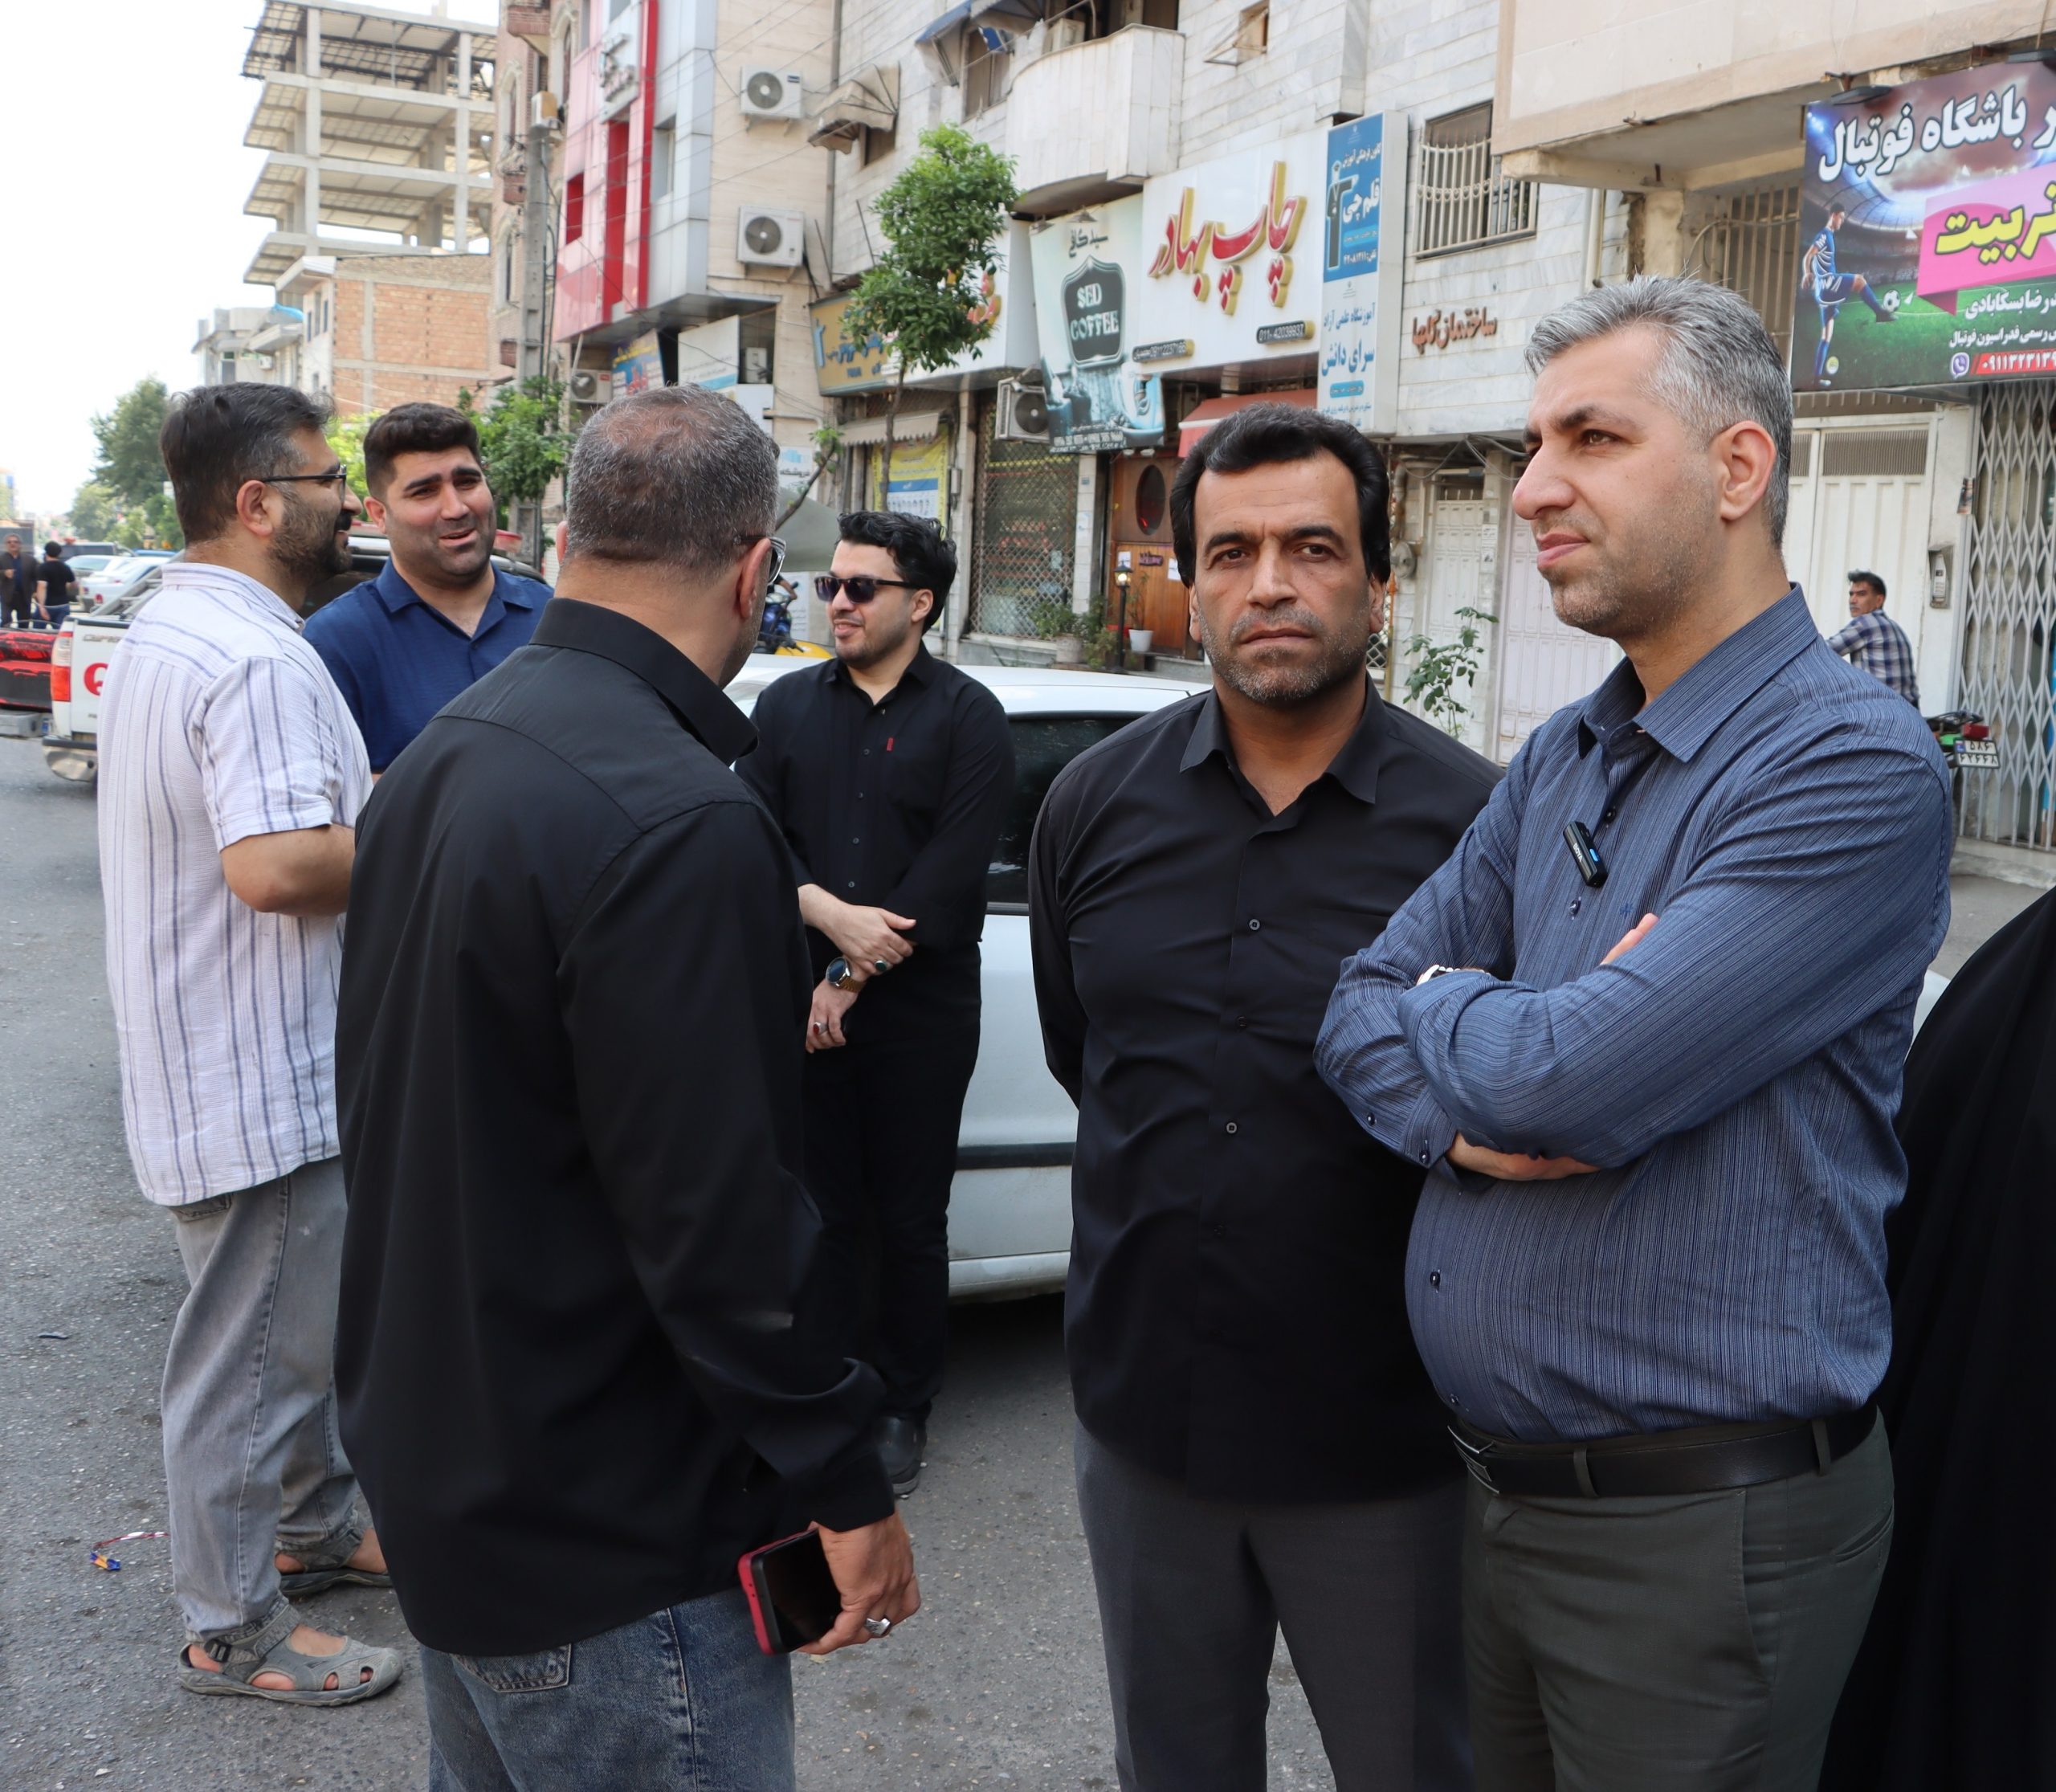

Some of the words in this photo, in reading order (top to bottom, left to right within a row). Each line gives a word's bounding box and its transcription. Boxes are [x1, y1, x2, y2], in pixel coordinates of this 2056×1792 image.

[1920, 84, 2027, 152] باشگاه
[1818, 102, 1915, 182] فوتبال
[1211, 160, 1307, 316] چاپ
[1077, 283, 1103, 309] SED
[1070, 310, 1120, 341] COFFEE
[1436, 306, 1497, 349] ساختمان
[1949, 328, 1976, 348] فوتبال
[1573, 843, 1583, 863] BOYA
